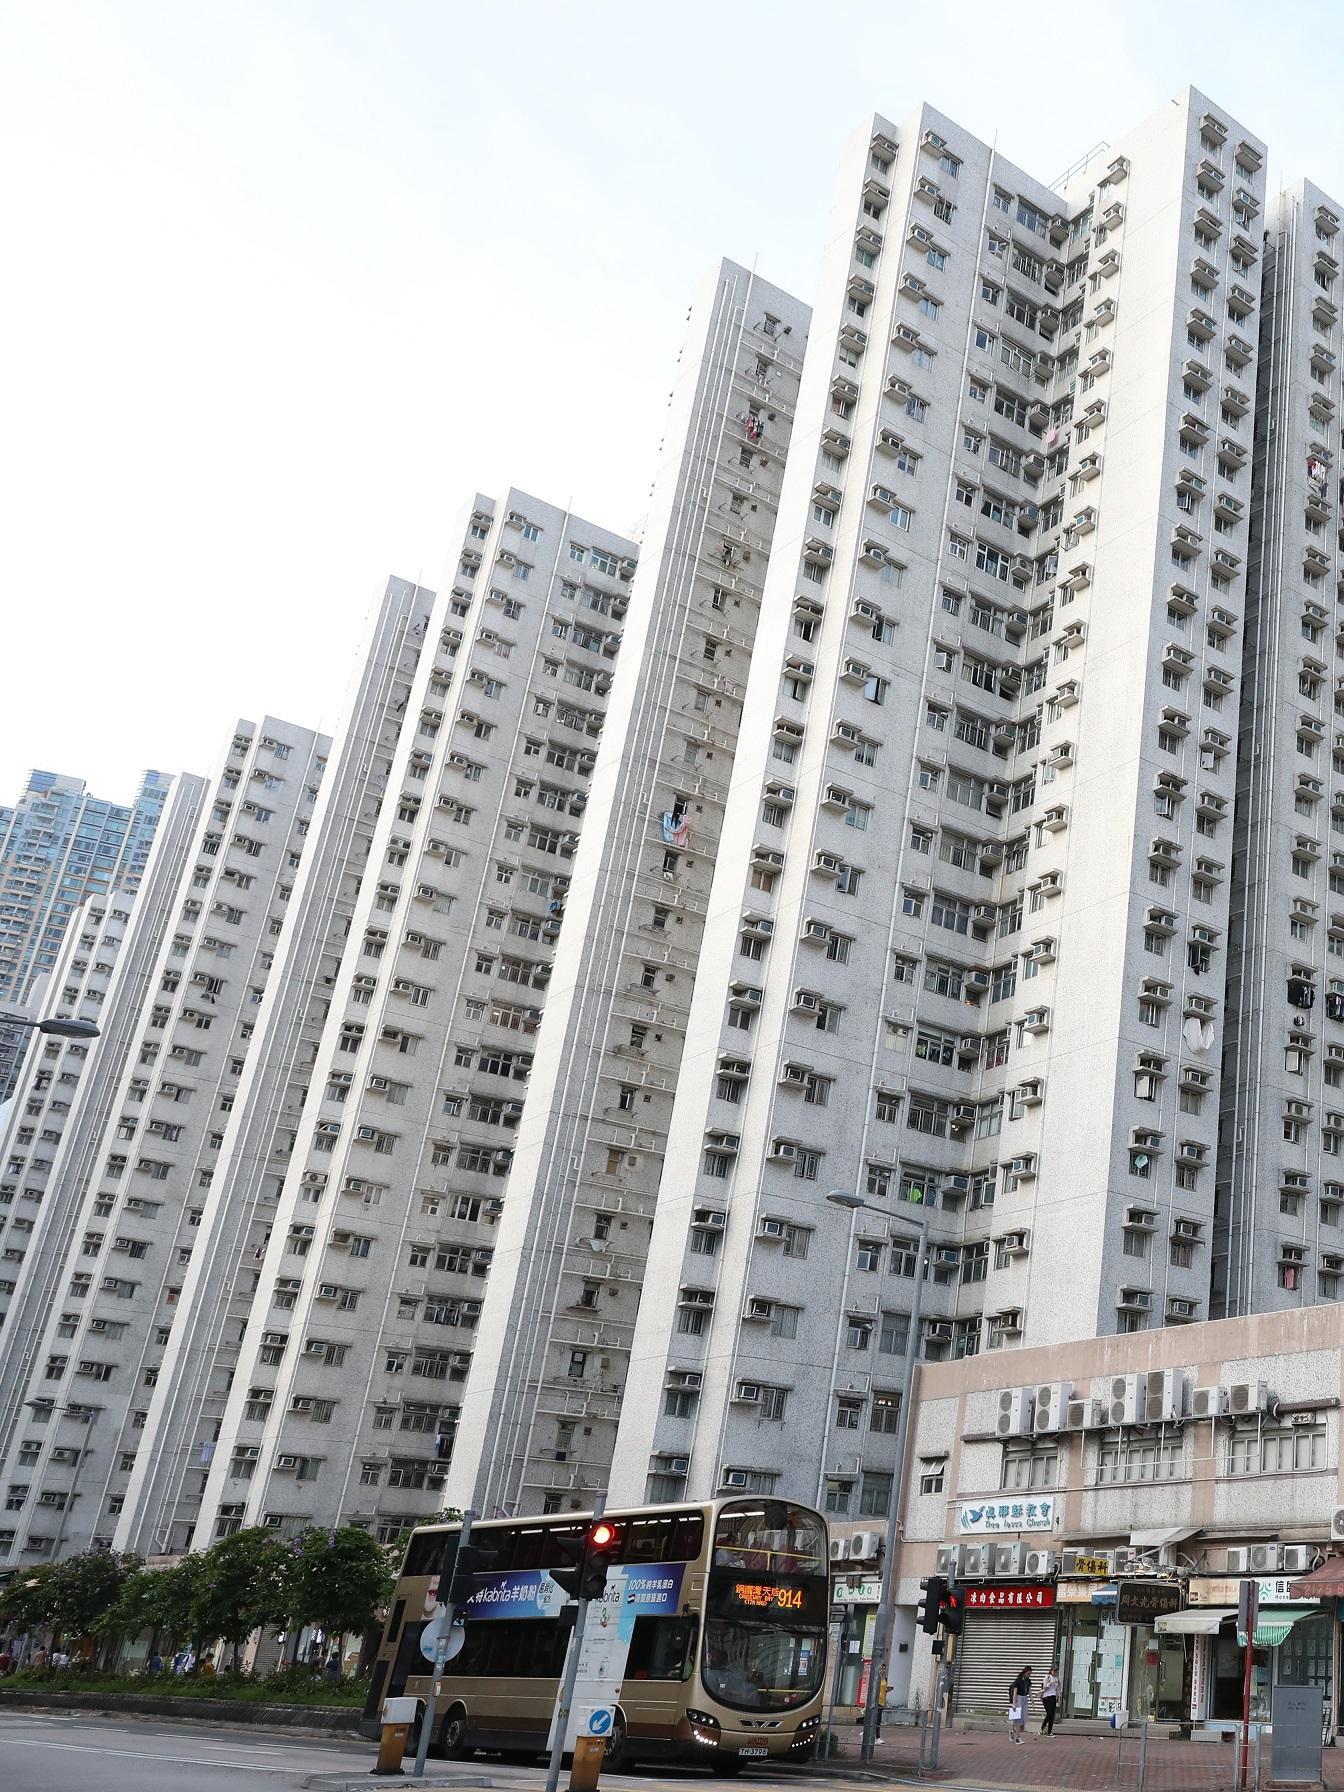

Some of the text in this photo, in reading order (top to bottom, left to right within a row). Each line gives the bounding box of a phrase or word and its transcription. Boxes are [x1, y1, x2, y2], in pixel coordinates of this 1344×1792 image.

[1076, 1558, 1108, 1574] 骨傷科
[778, 1589, 802, 1608] 914
[970, 1591, 1043, 1604] 凍肉食品有限公司
